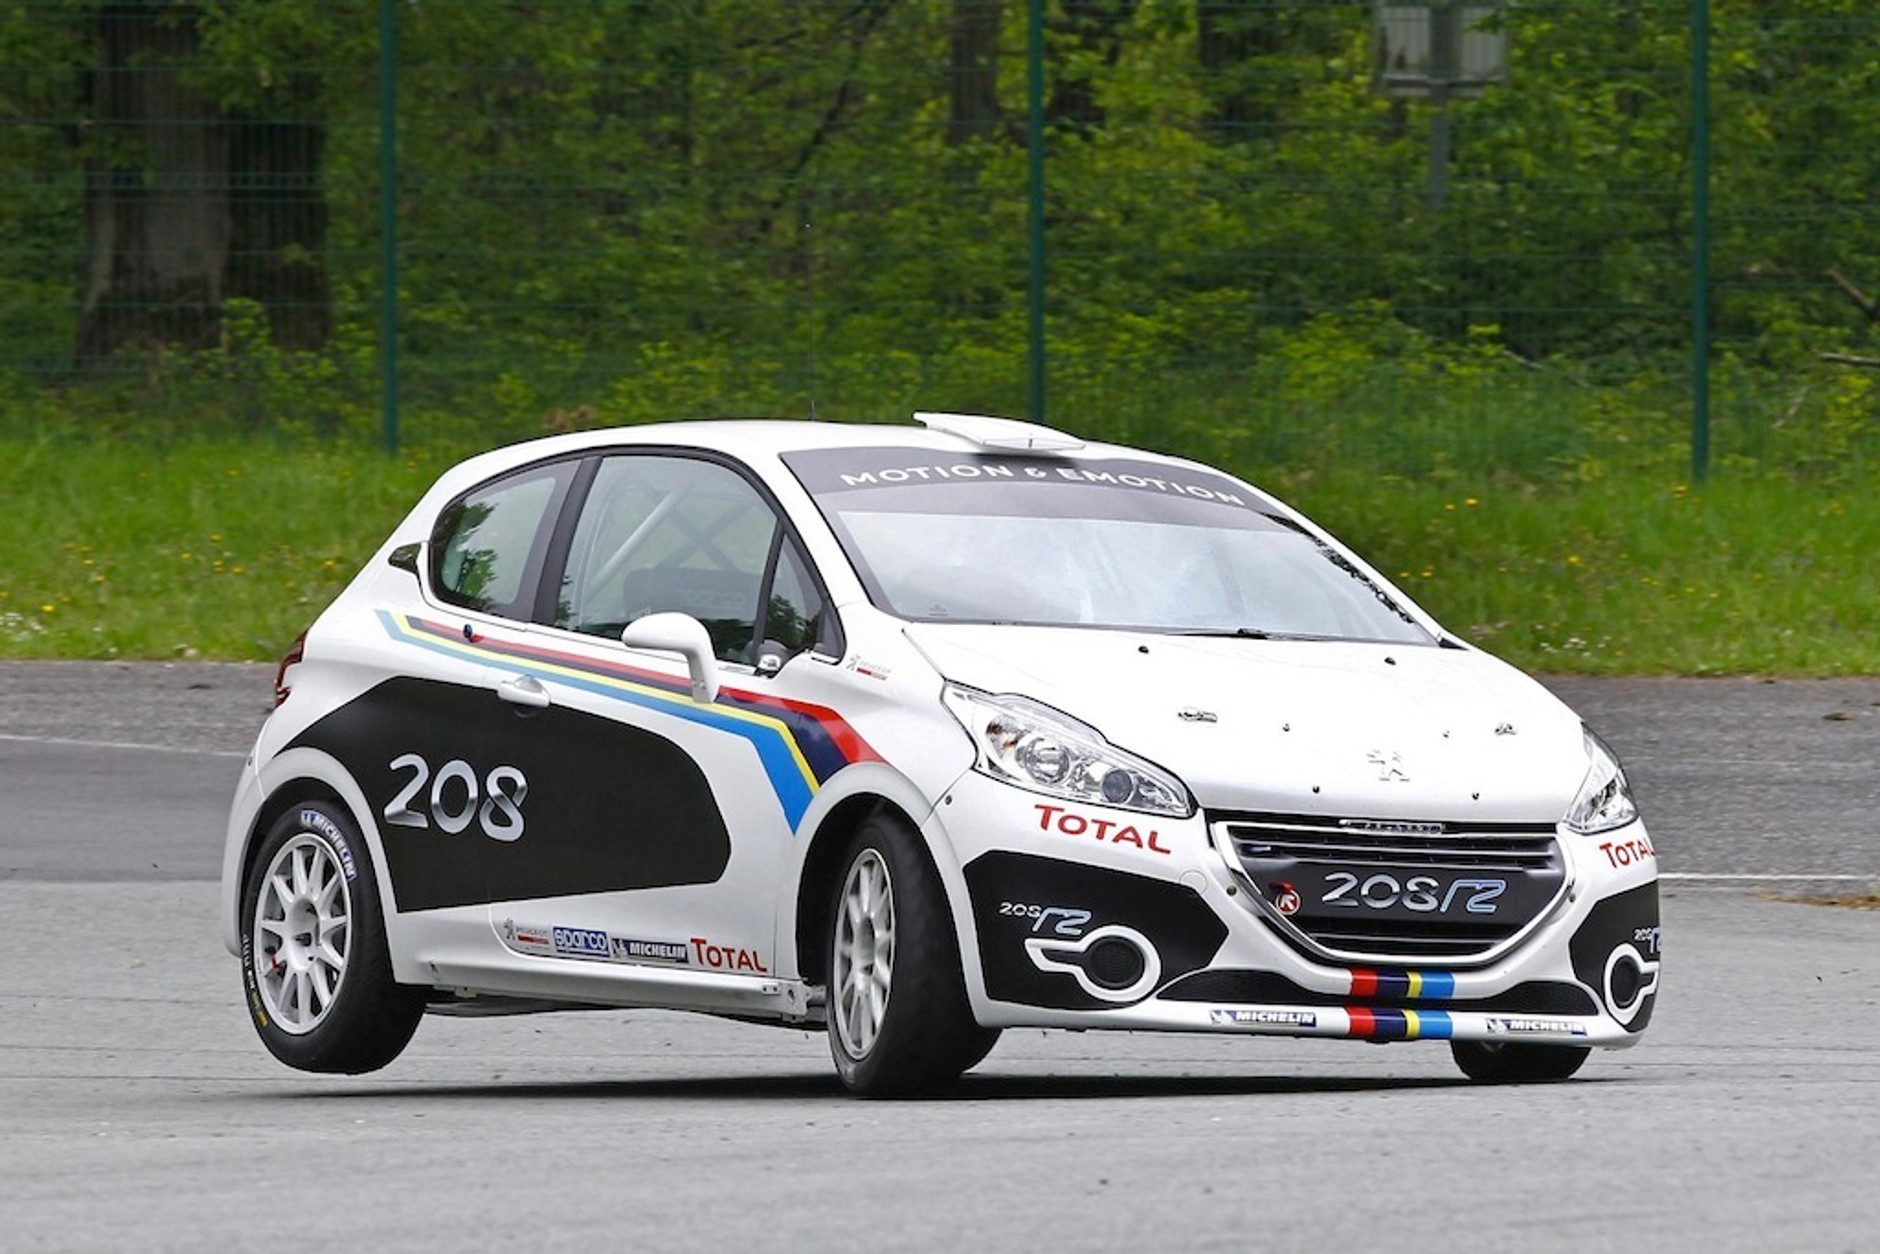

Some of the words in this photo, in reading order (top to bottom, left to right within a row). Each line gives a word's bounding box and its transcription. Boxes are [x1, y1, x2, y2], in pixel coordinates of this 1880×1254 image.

[840, 464, 1013, 486] MOTION
[1024, 467, 1043, 479] &
[1056, 468, 1244, 505] EMOTION
[384, 753, 528, 842] 208
[629, 943, 686, 959] MICHELIN
[1234, 1012, 1315, 1024] MICHELIN
[1508, 1020, 1587, 1033] MICHELIN
